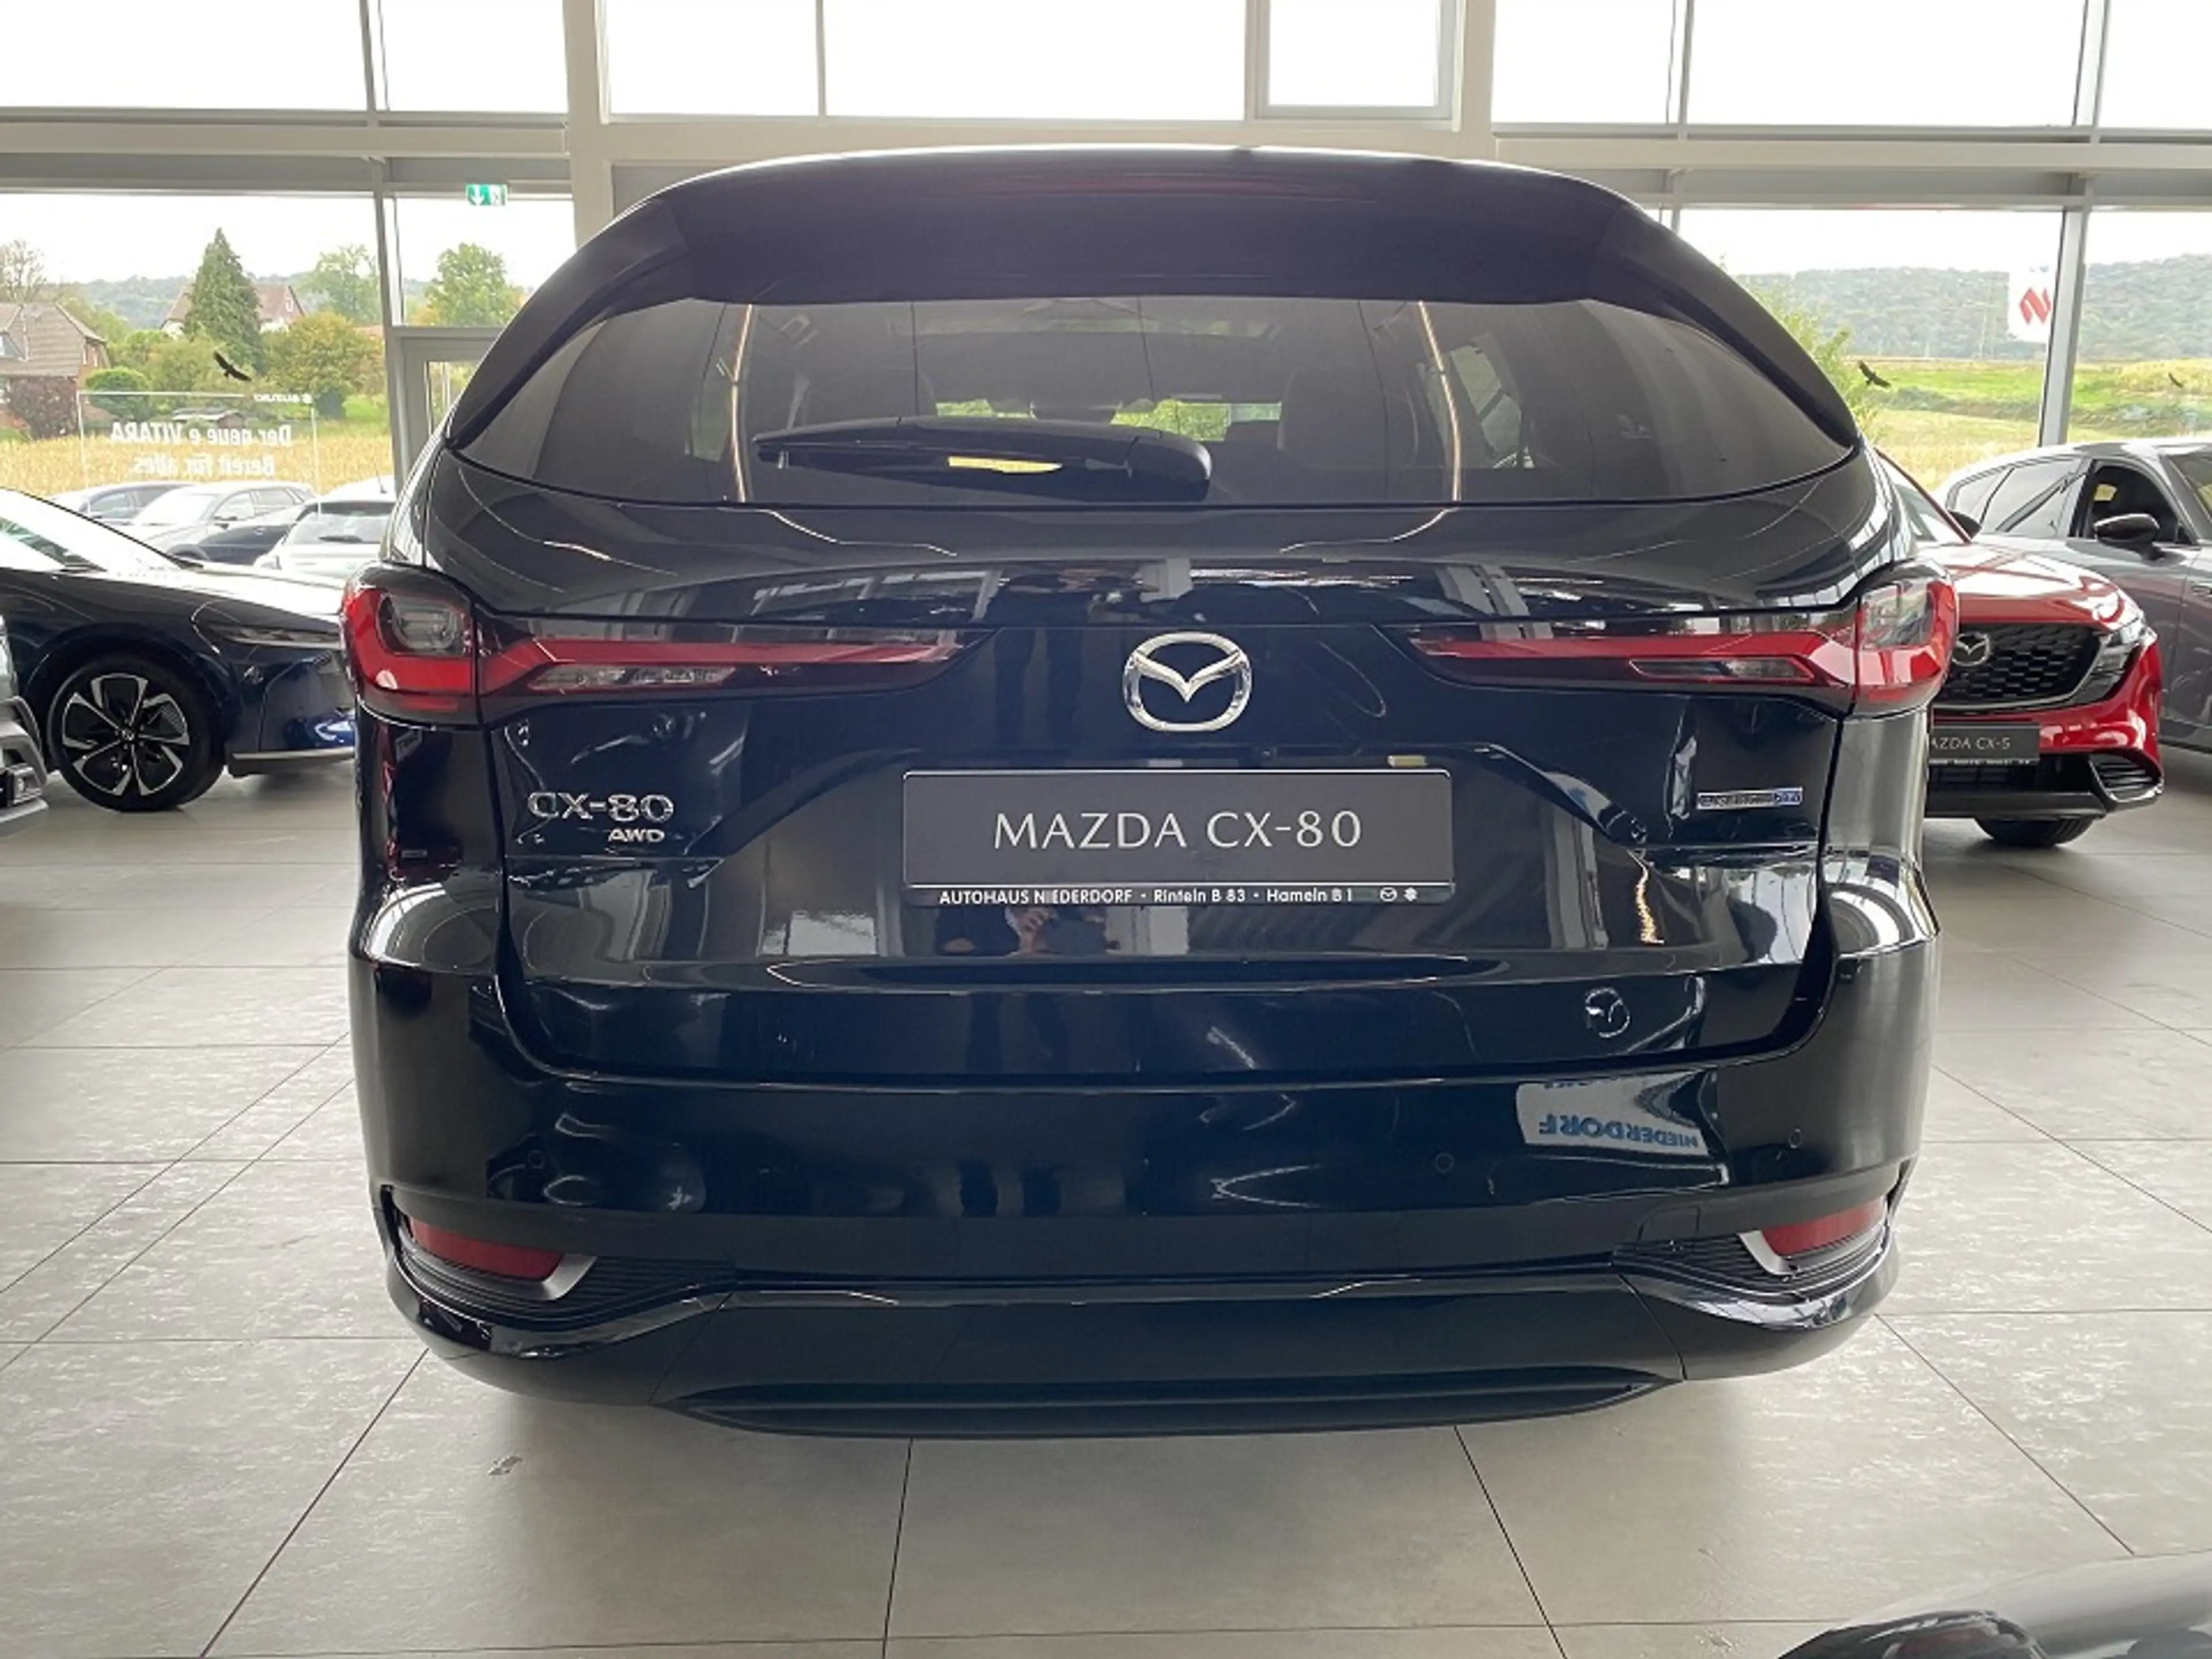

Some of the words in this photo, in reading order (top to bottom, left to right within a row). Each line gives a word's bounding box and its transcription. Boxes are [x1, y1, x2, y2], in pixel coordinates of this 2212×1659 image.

[1931, 737, 1971, 749] AZDA
[1976, 737, 2010, 750] CX-5
[527, 791, 674, 823] CX-80
[608, 828, 665, 843] AWD
[994, 812, 1187, 849] MAZDA
[1206, 810, 1362, 848] CX-80
[940, 889, 1030, 905] AUTOHAUS
[1034, 889, 1134, 904] NIEDERDORF
[1153, 889, 1207, 903] Rinteln
[1211, 889, 1222, 903] B
[1226, 889, 1247, 902] 83
[1267, 889, 1327, 903] Hameln
[1539, 1113, 1699, 1148] NIEDERDORF
